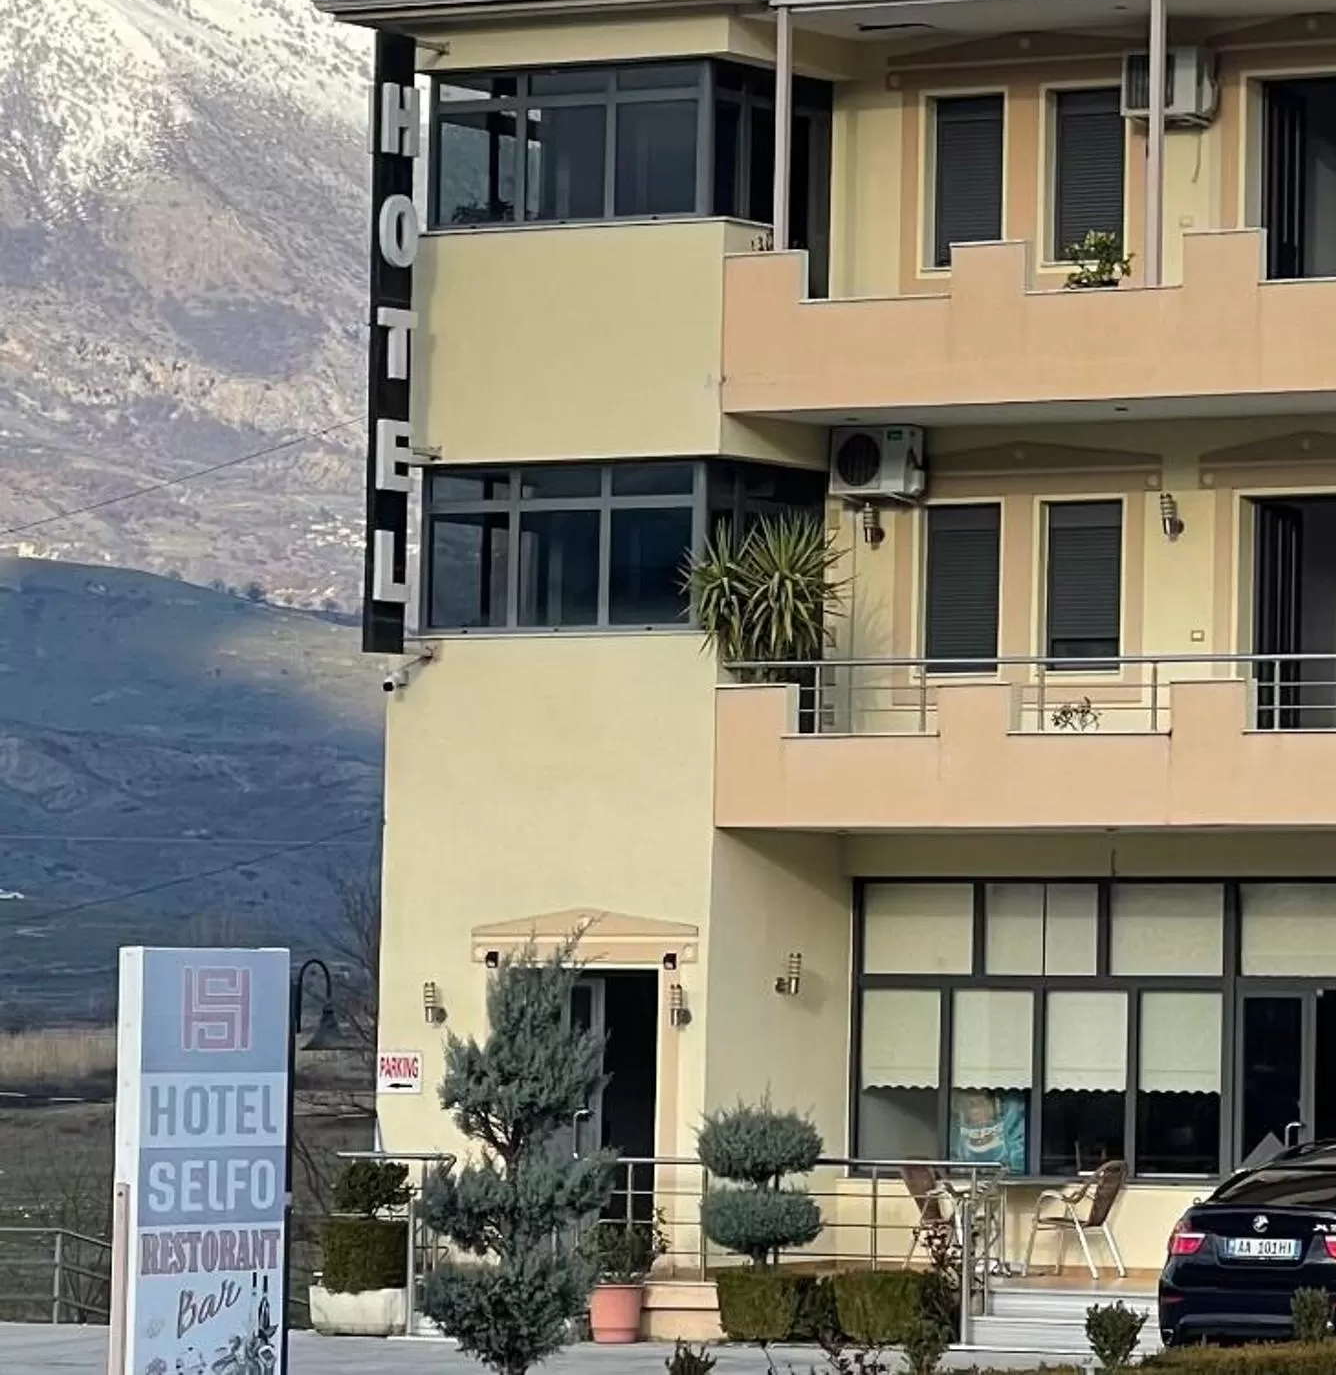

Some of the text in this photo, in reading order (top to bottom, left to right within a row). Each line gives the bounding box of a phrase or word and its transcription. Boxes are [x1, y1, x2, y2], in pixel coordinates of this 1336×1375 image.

[373, 82, 420, 603] HOTEL
[379, 1056, 418, 1079] PARKING
[150, 1084, 277, 1137] HOTEL
[148, 1159, 276, 1213] SELFO
[141, 1230, 280, 1275] RESTORANT
